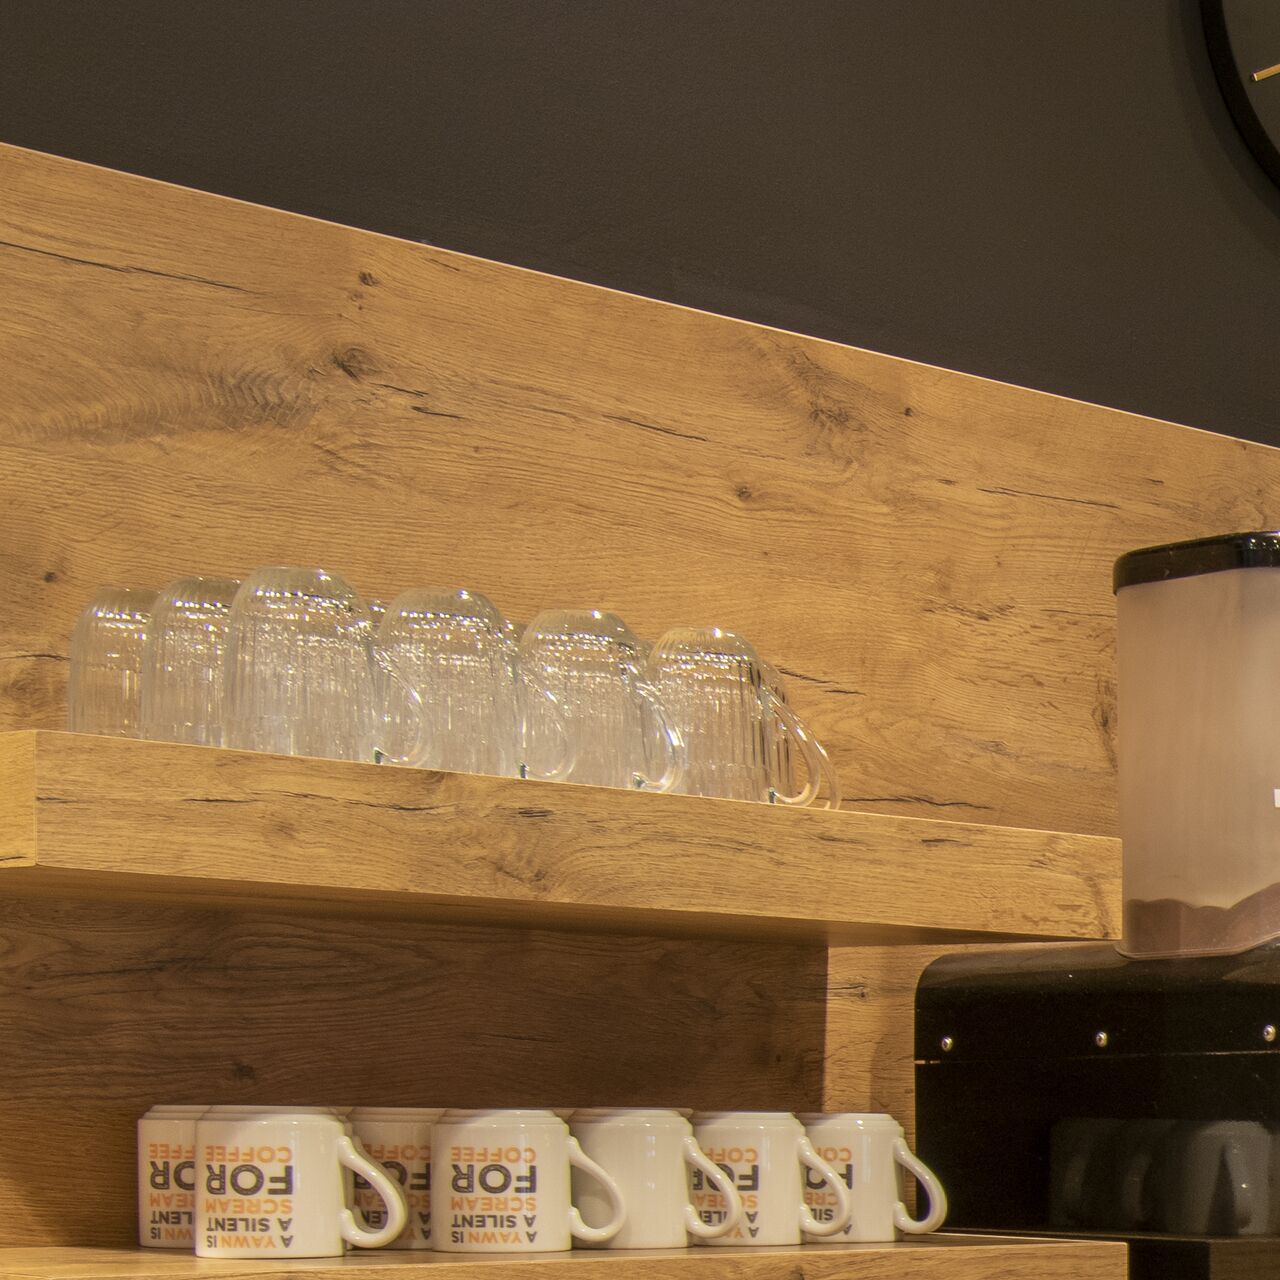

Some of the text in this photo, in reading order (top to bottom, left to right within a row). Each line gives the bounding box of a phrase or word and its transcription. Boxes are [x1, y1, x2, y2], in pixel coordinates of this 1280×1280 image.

[149, 1143, 195, 1160] FFEE
[205, 1145, 293, 1163] COFFEE
[451, 1146, 537, 1163] COFFEE
[149, 1161, 195, 1191] OR
[206, 1164, 294, 1196] FOR
[451, 1163, 537, 1194] FOR
[205, 1198, 293, 1215] SCREAM
[451, 1197, 537, 1212] SCREAM
[150, 1210, 193, 1225] LENT
[206, 1217, 293, 1232] A SILENT
[418, 1211, 431, 1225] A
[451, 1214, 537, 1228] A SILENT
[746, 1211, 758, 1224] A
[150, 1228, 161, 1240] IS
[420, 1228, 431, 1240] A
[451, 1231, 537, 1244] A YAWN IS
[748, 1226, 759, 1238] A
[206, 1235, 294, 1249] A YAWN IS
